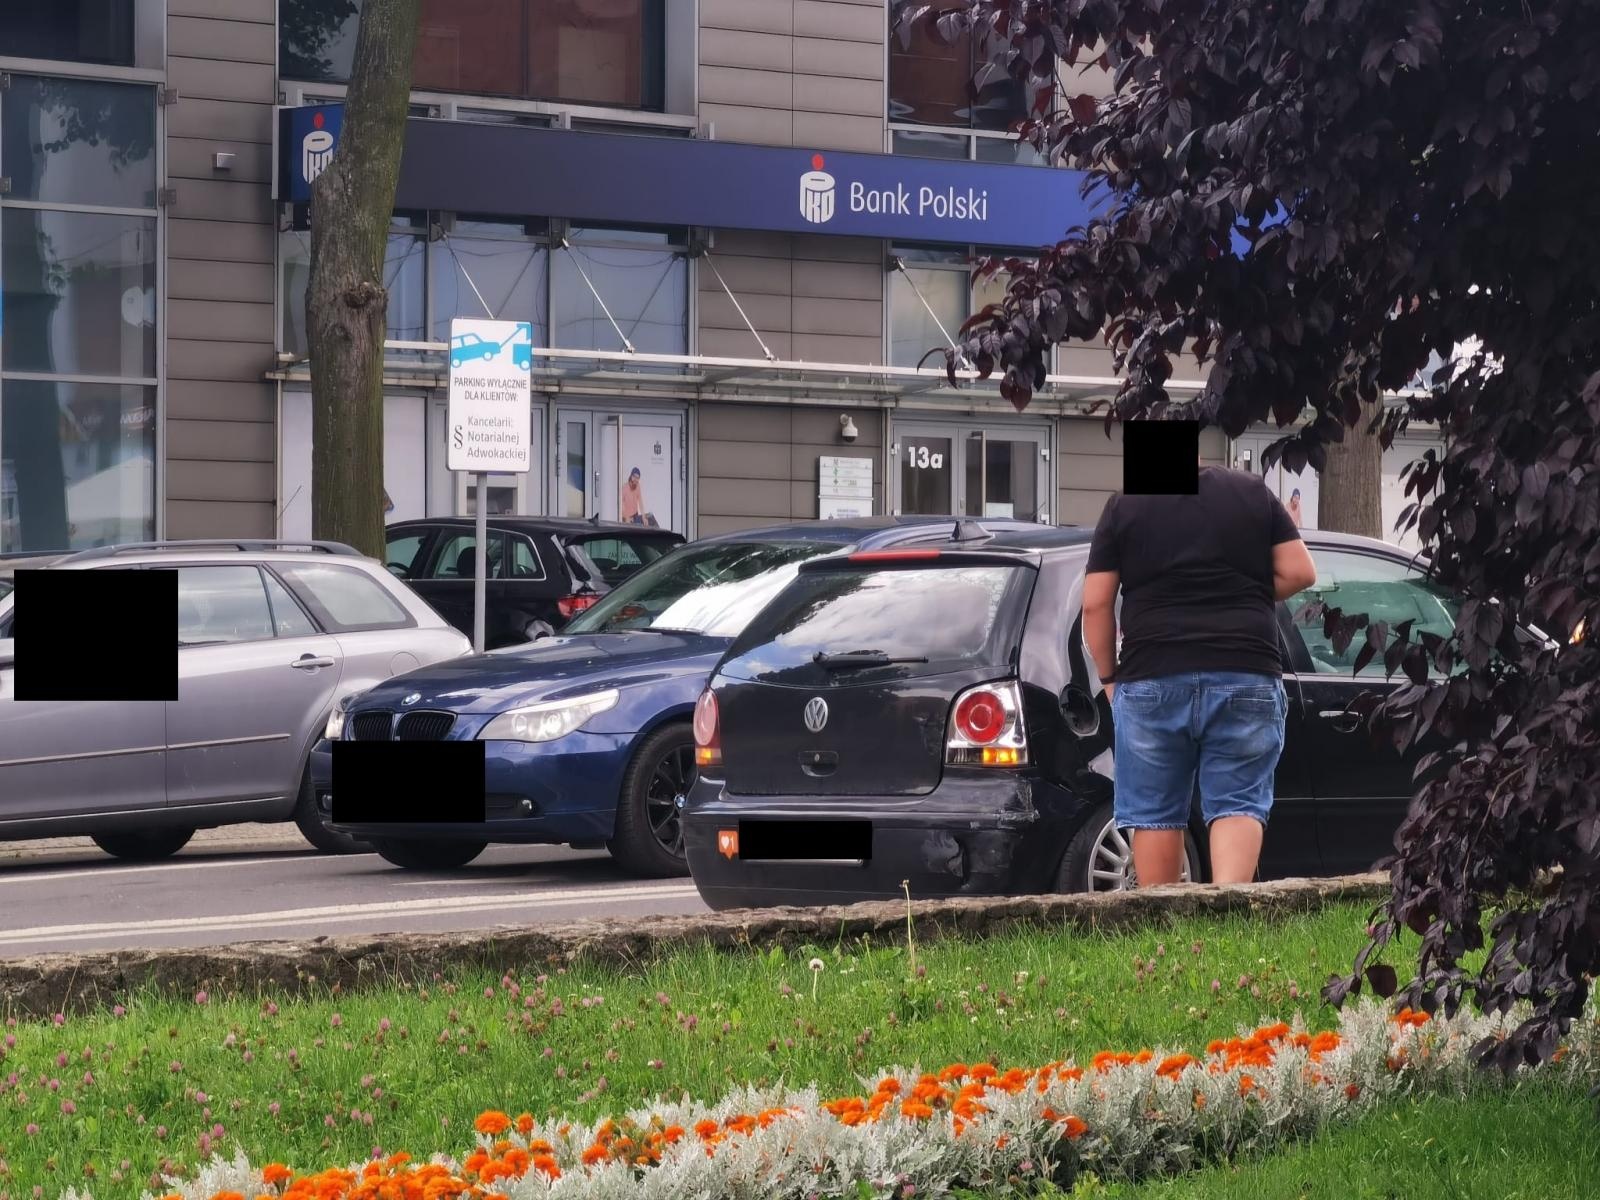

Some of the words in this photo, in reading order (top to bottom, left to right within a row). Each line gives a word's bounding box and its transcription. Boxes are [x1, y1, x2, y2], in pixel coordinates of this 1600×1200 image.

[850, 182, 911, 216] Bank
[919, 186, 987, 221] Polski
[454, 377, 486, 388] PARKING
[487, 379, 527, 390] WYŁĄCZNIE
[464, 391, 479, 401] DLA
[467, 431, 520, 445] Notarialnej
[467, 447, 526, 461] Adwokackiej
[908, 446, 943, 469] 13a
